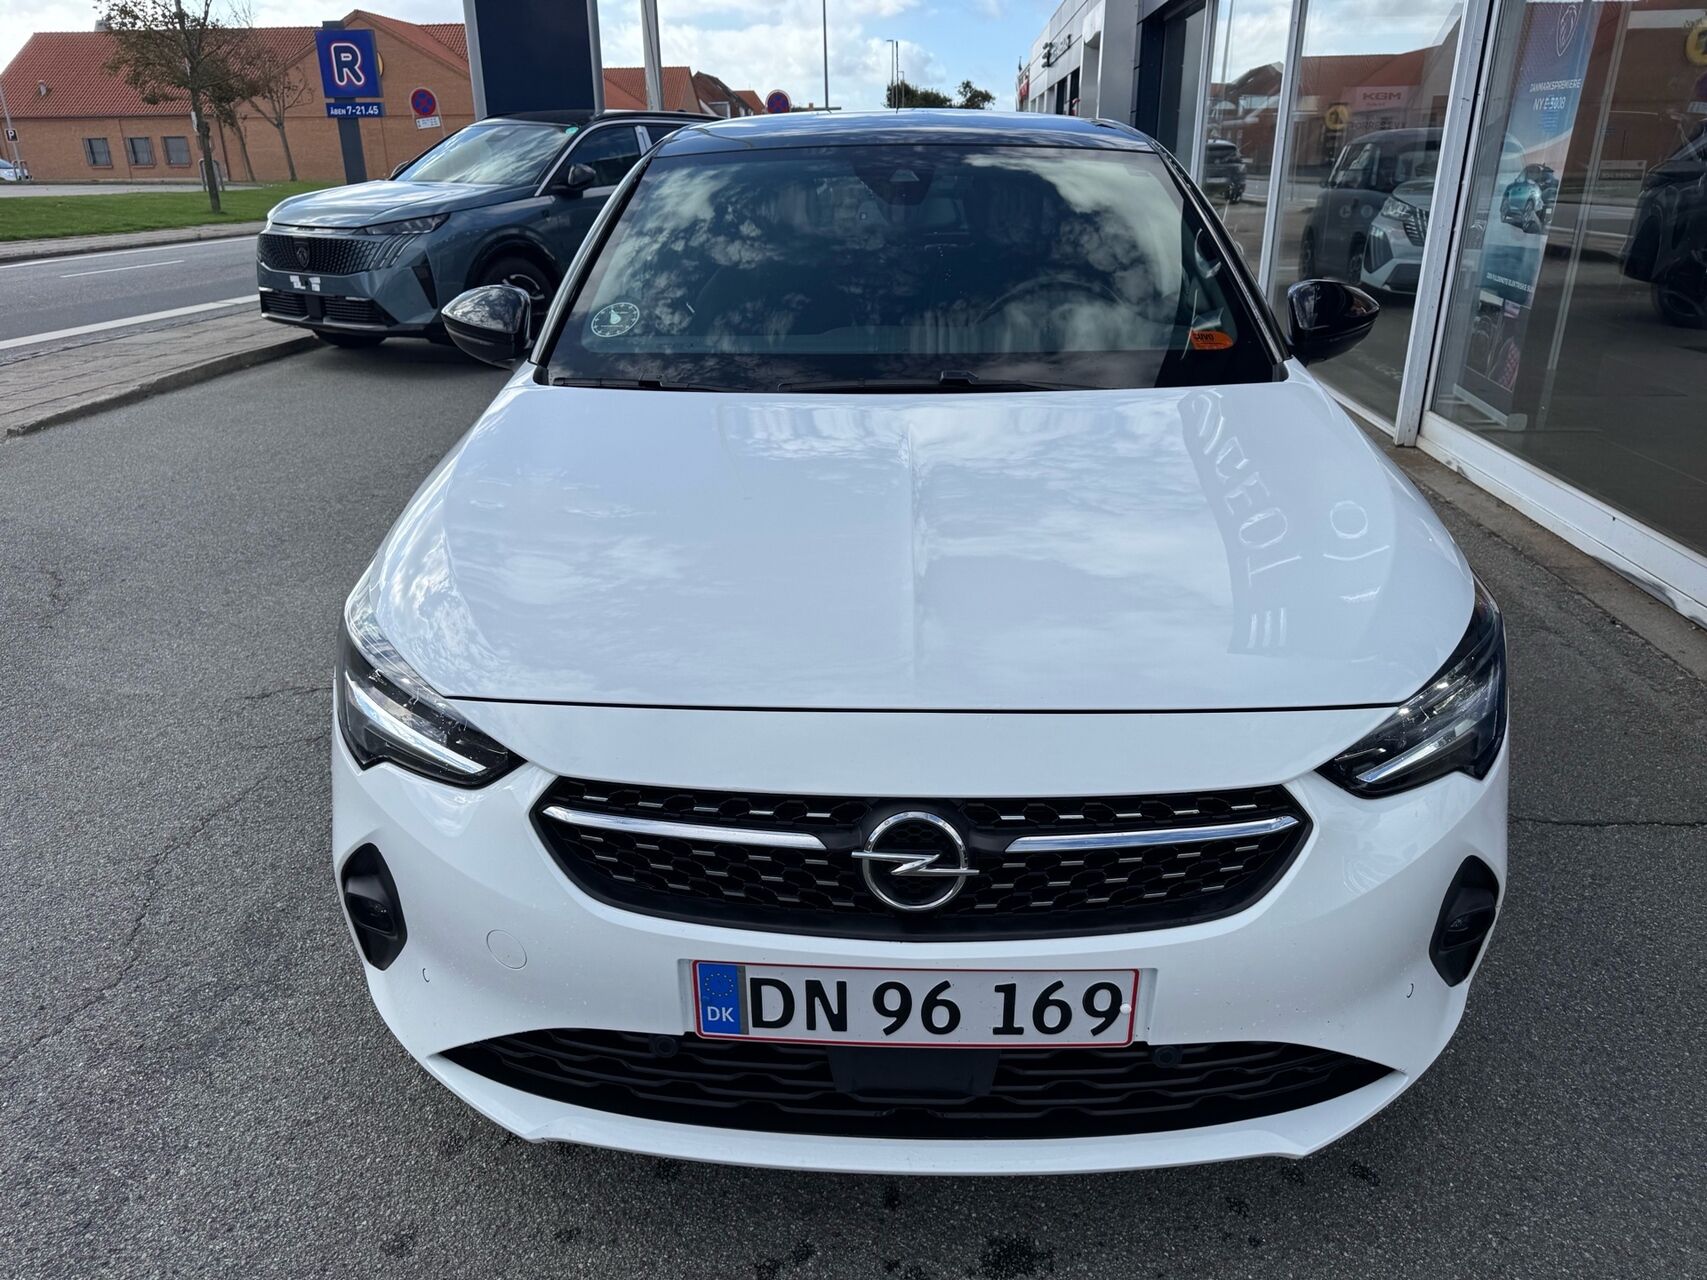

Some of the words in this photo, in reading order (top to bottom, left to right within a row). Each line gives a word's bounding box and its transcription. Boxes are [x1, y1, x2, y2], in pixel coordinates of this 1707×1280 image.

[331, 43, 364, 86] R
[1363, 92, 1402, 101] KGM
[1533, 97, 1545, 111] NY
[8, 130, 14, 139] P
[707, 1006, 735, 1023] DK
[749, 977, 848, 1032] DN
[872, 980, 961, 1036] 96
[992, 980, 1123, 1037] 169
